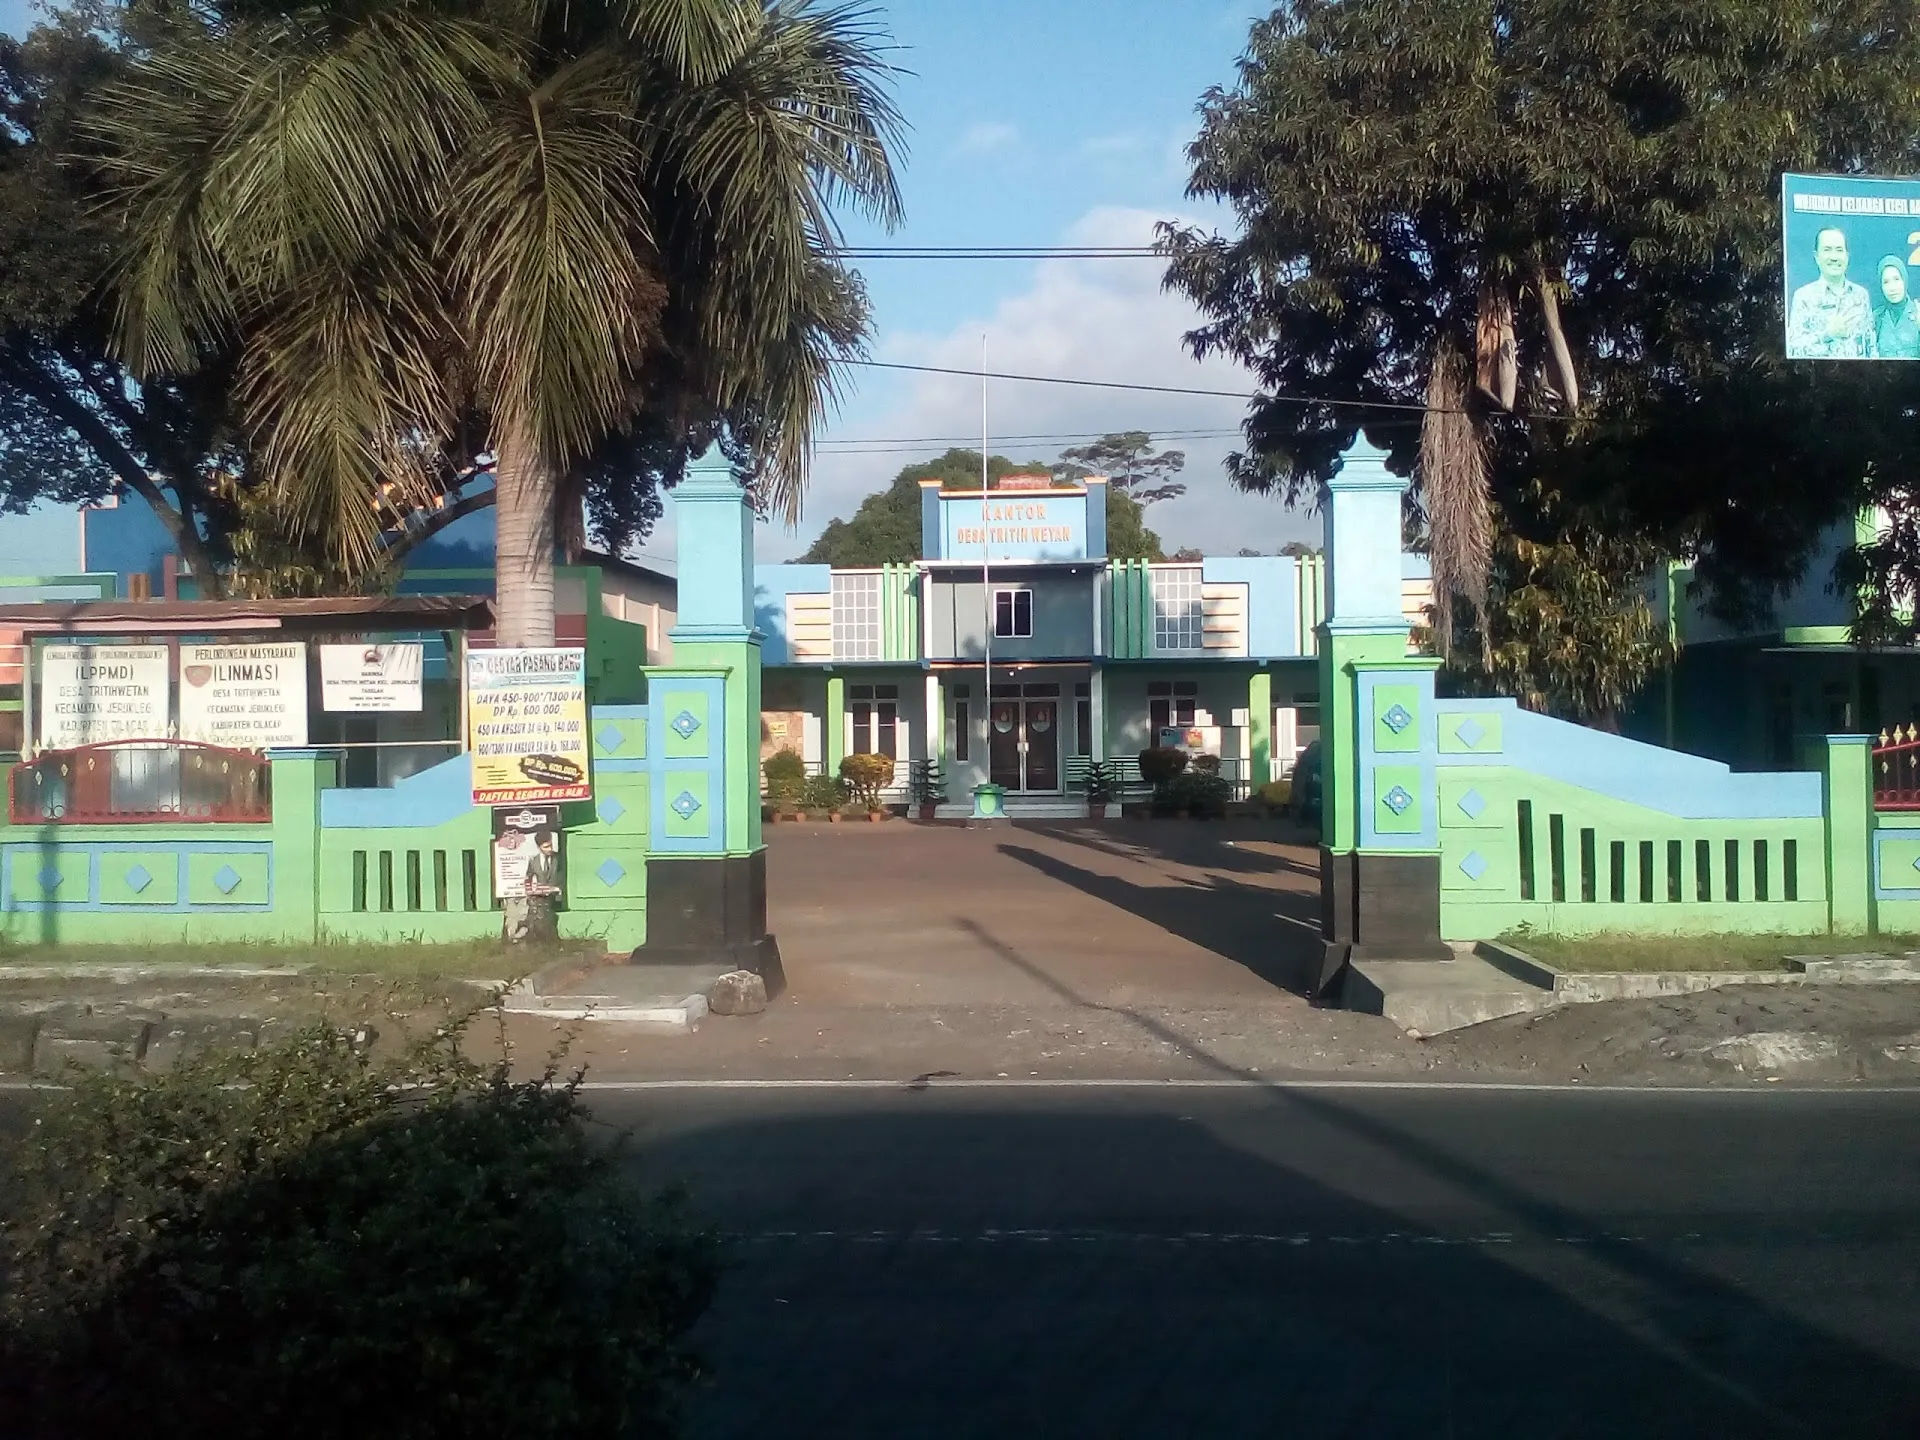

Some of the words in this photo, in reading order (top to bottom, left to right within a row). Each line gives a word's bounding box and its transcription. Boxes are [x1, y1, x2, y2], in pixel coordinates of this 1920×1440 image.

[982, 503, 1046, 521] KANTOR
[195, 649, 247, 660] PERLINDUNGAN
[250, 647, 297, 659] MASYARAKAT
[523, 655, 557, 672] PASANG
[76, 665, 133, 680] (LPPMD)
[214, 664, 279, 682] (LINMAS)
[477, 693, 500, 704] DAYA
[571, 691, 583, 701] VA
[493, 706, 506, 717] DP
[477, 724, 491, 736] 450
[479, 790, 515, 803] DAFTAR
[515, 789, 551, 801] SEGERA
[552, 788, 565, 799] KE
